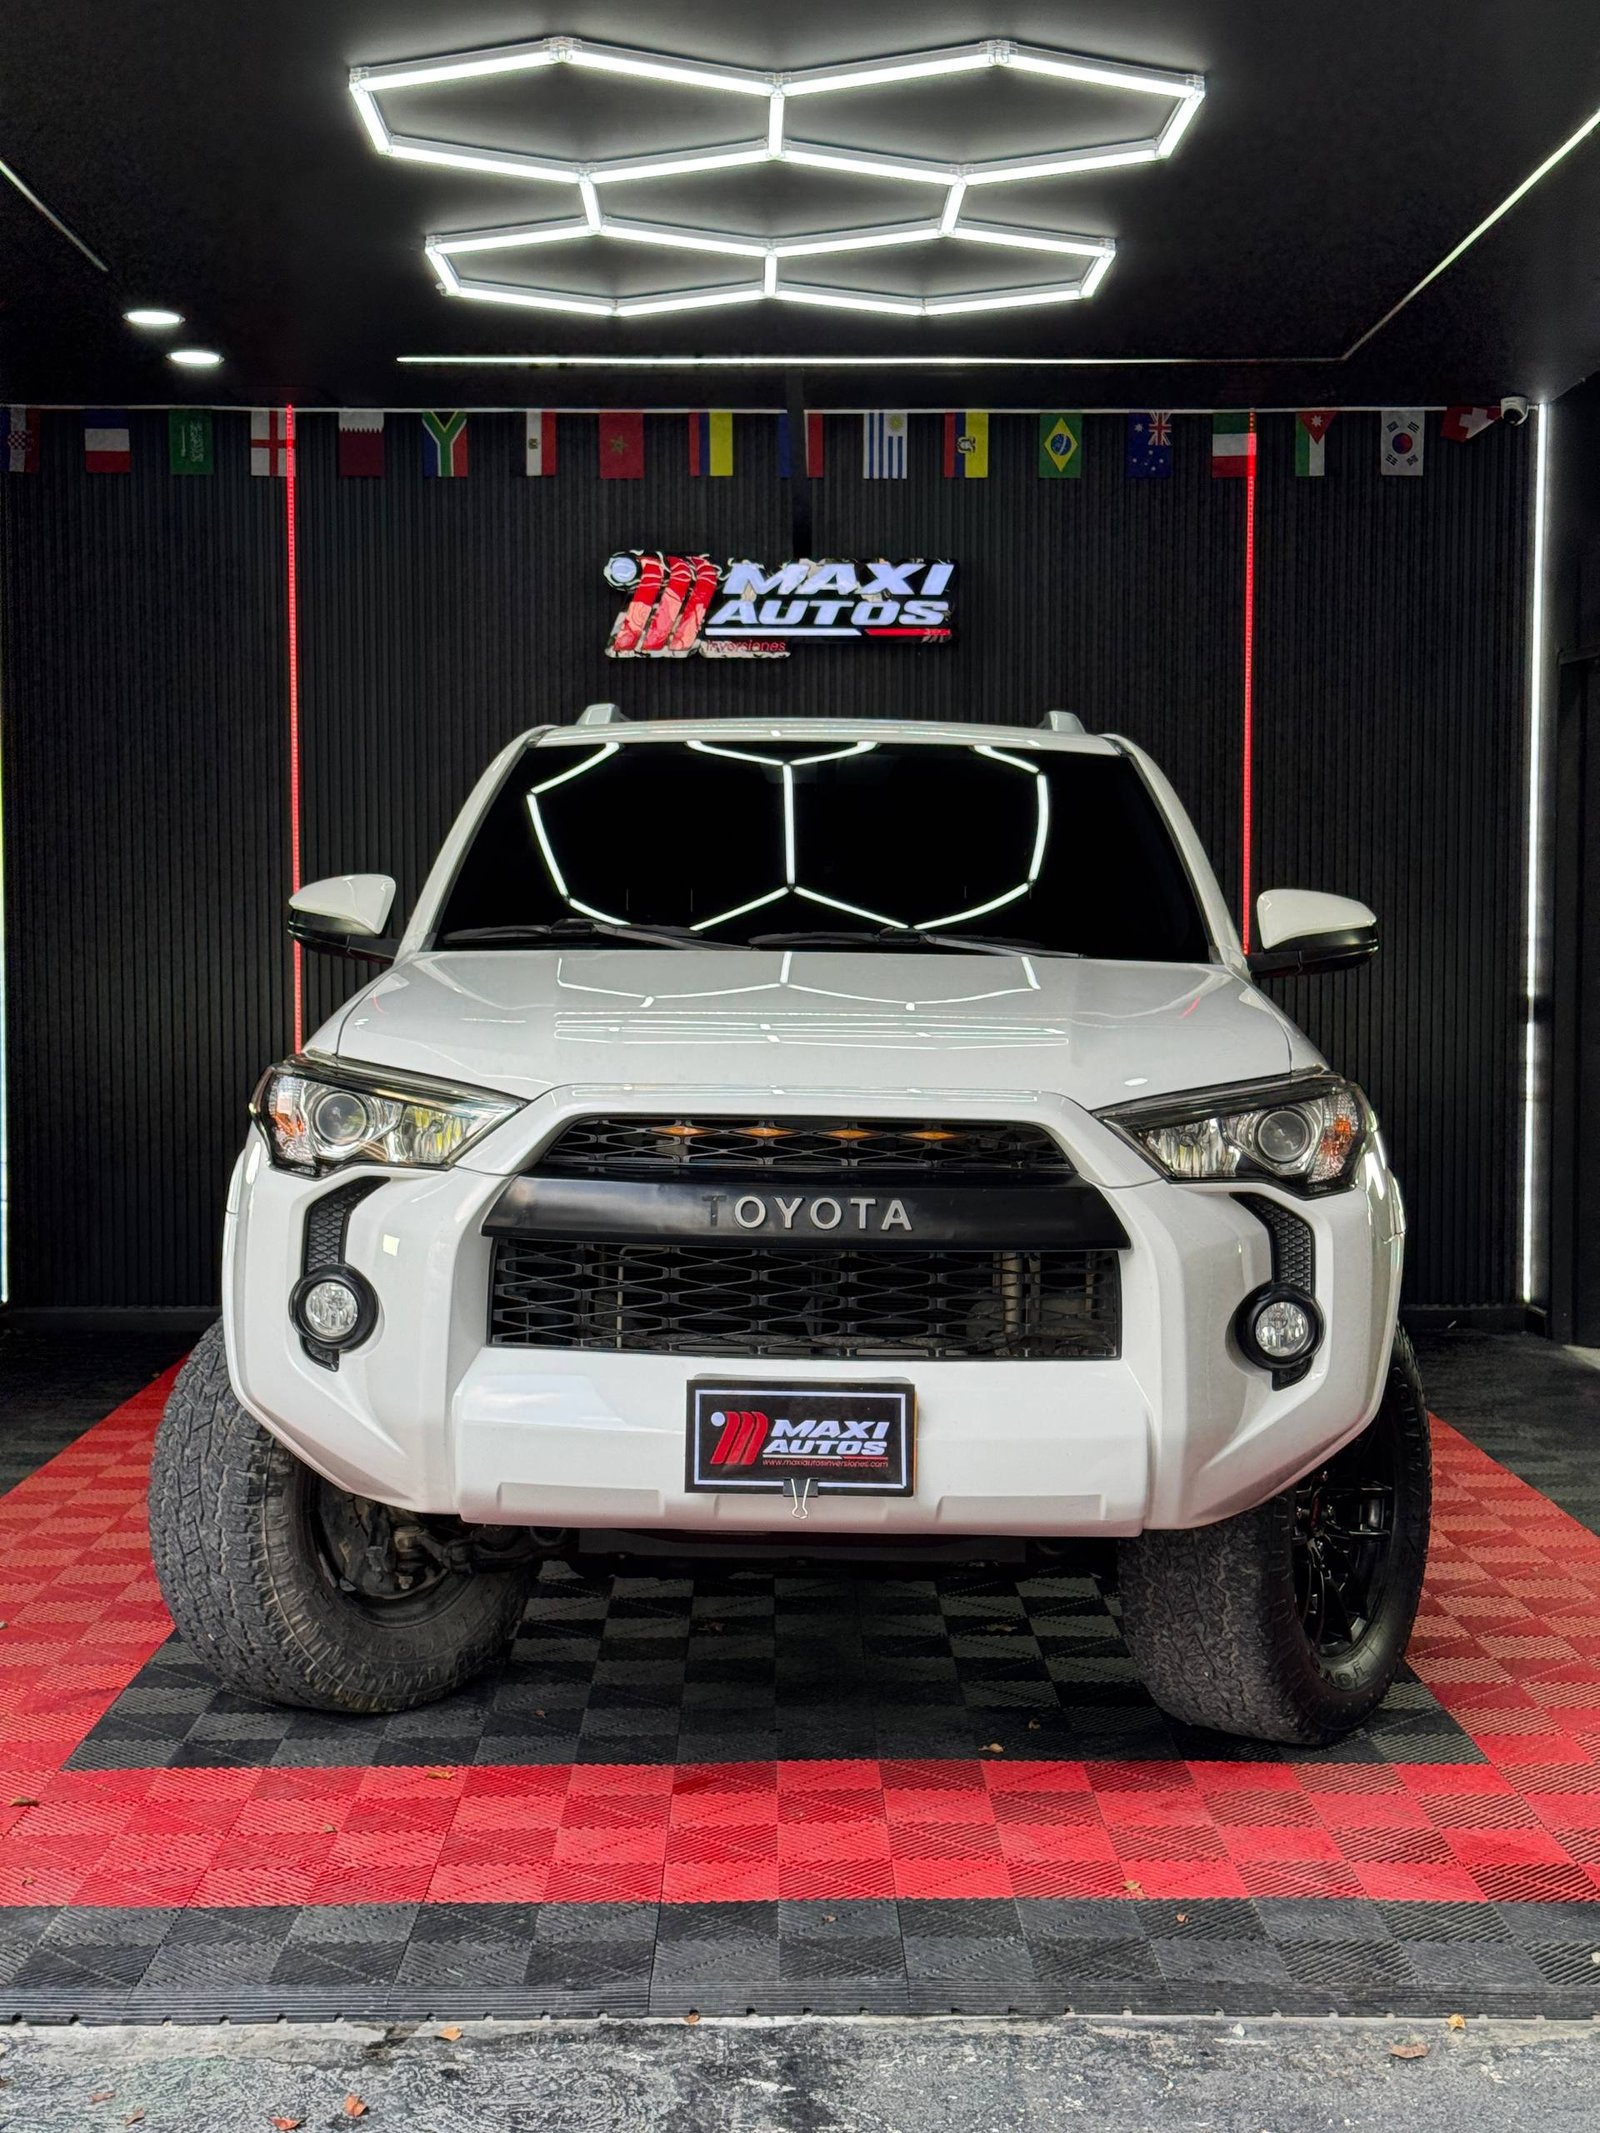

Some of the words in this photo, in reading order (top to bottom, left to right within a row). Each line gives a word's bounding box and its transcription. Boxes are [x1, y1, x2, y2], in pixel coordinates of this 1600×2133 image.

[722, 562, 955, 596] MAXI
[708, 600, 951, 626] AUTOS
[701, 1195, 913, 1232] TOYOTA
[770, 1419, 890, 1440] MAXI
[762, 1440, 888, 1456] AUTOS
[762, 1458, 889, 1468] www.maxiautosinversiones.com
